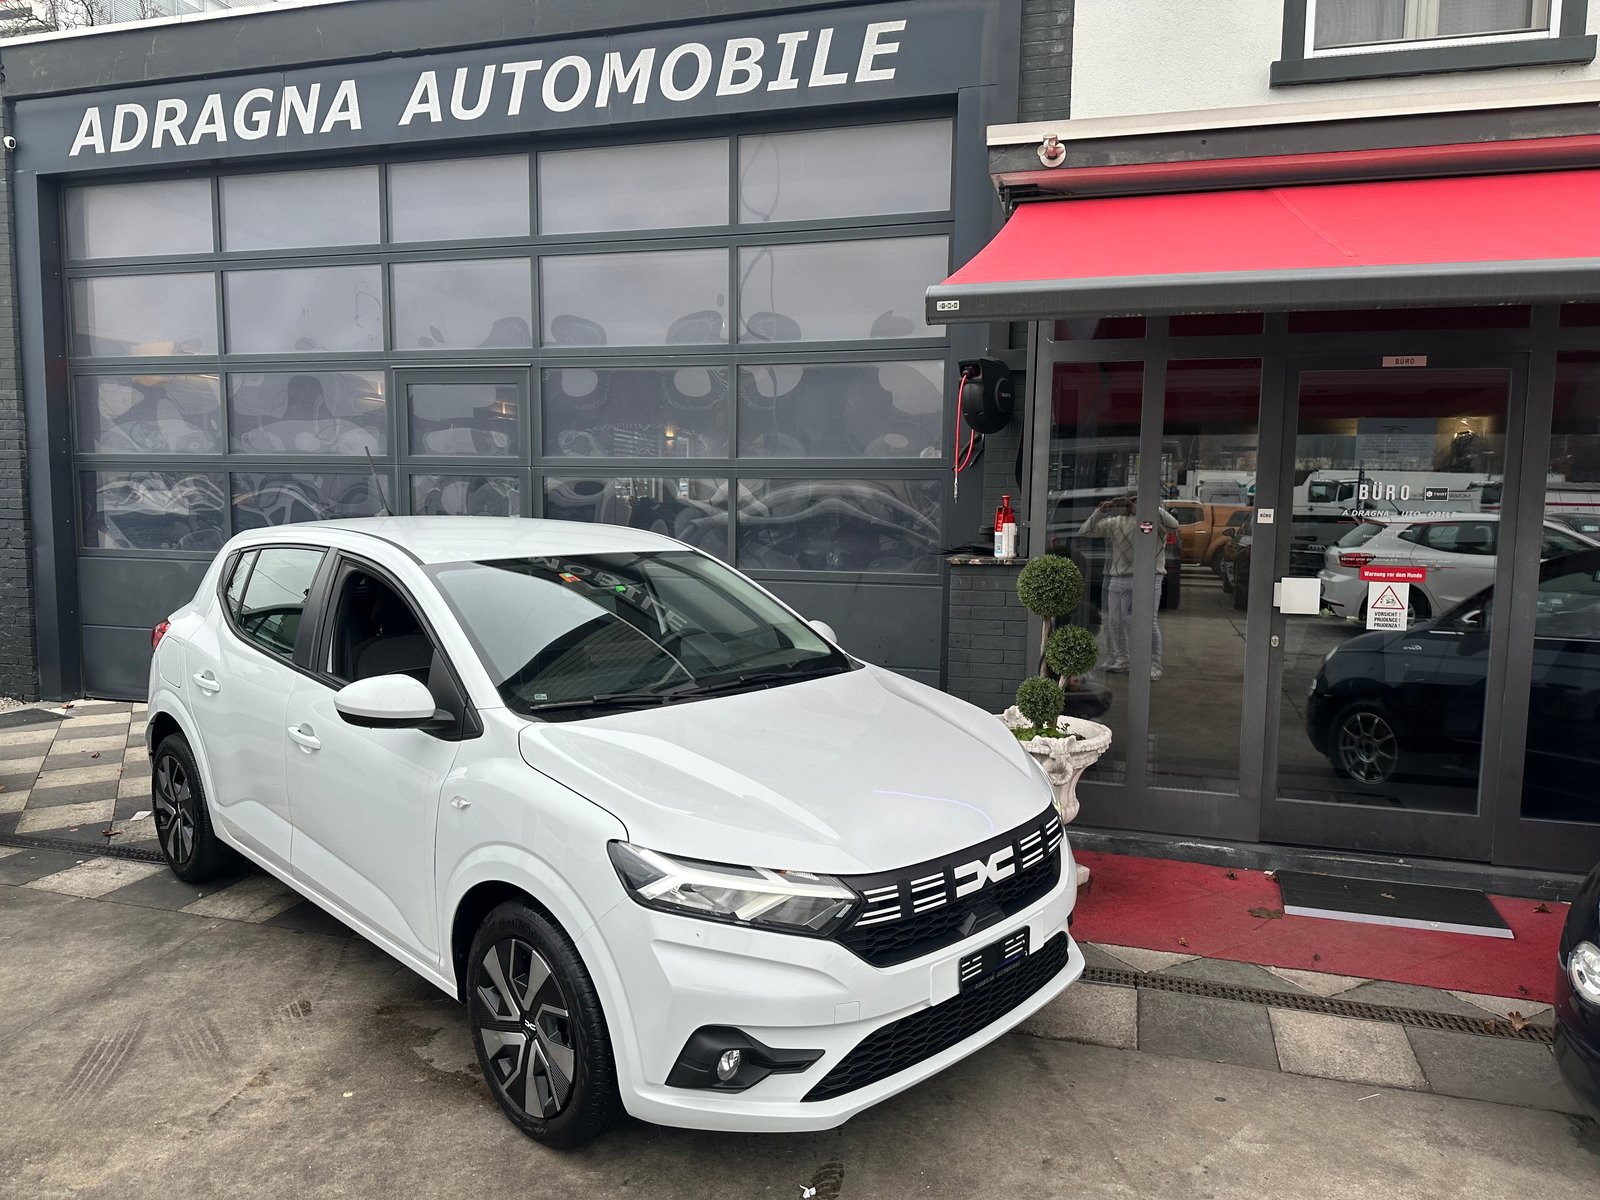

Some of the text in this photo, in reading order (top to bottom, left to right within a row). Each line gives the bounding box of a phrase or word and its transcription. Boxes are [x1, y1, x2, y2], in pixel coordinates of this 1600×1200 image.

[68, 19, 907, 157] ADRAGNA AUTOMOBILE
[1395, 357, 1415, 365] BÜRO
[1358, 482, 1410, 500] BÜRO
